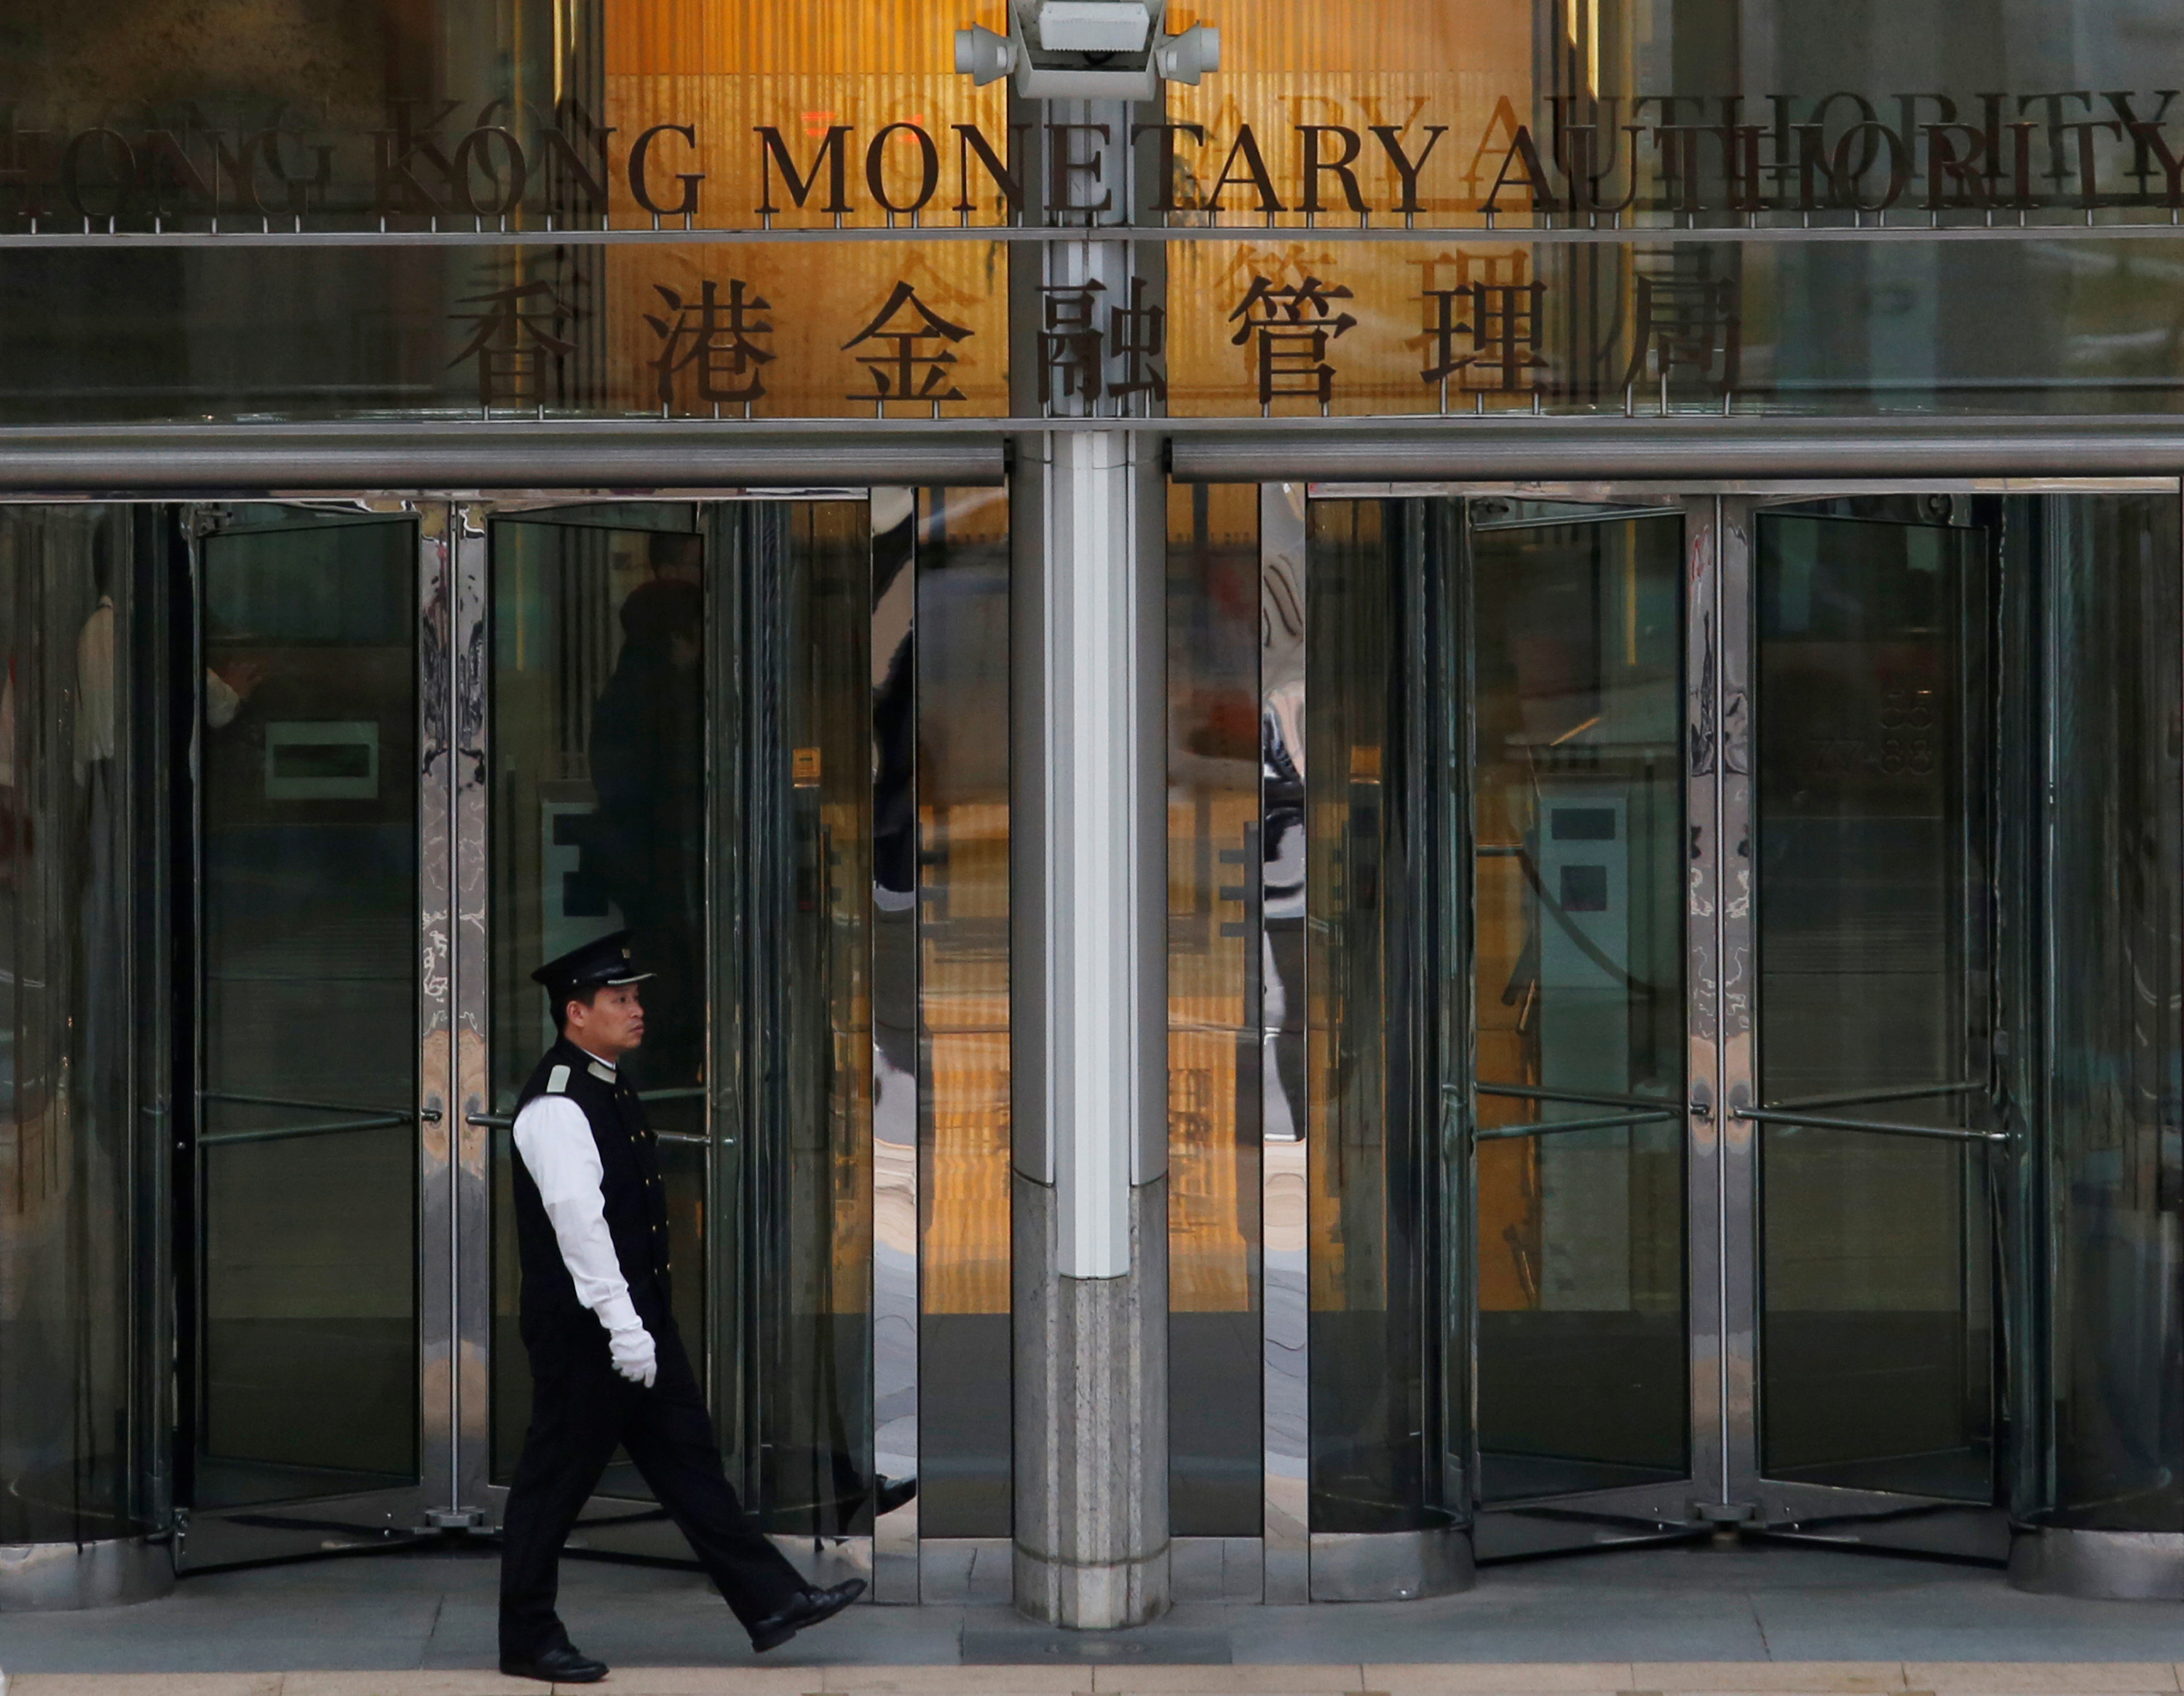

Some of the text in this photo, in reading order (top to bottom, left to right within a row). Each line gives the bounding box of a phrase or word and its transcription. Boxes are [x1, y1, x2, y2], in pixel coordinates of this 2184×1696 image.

[367, 123, 705, 216] KONG
[753, 122, 1449, 215] MONETARY
[1477, 121, 2184, 214] AUTHORITY
[446, 275, 1741, 406] 香港金融管理局
